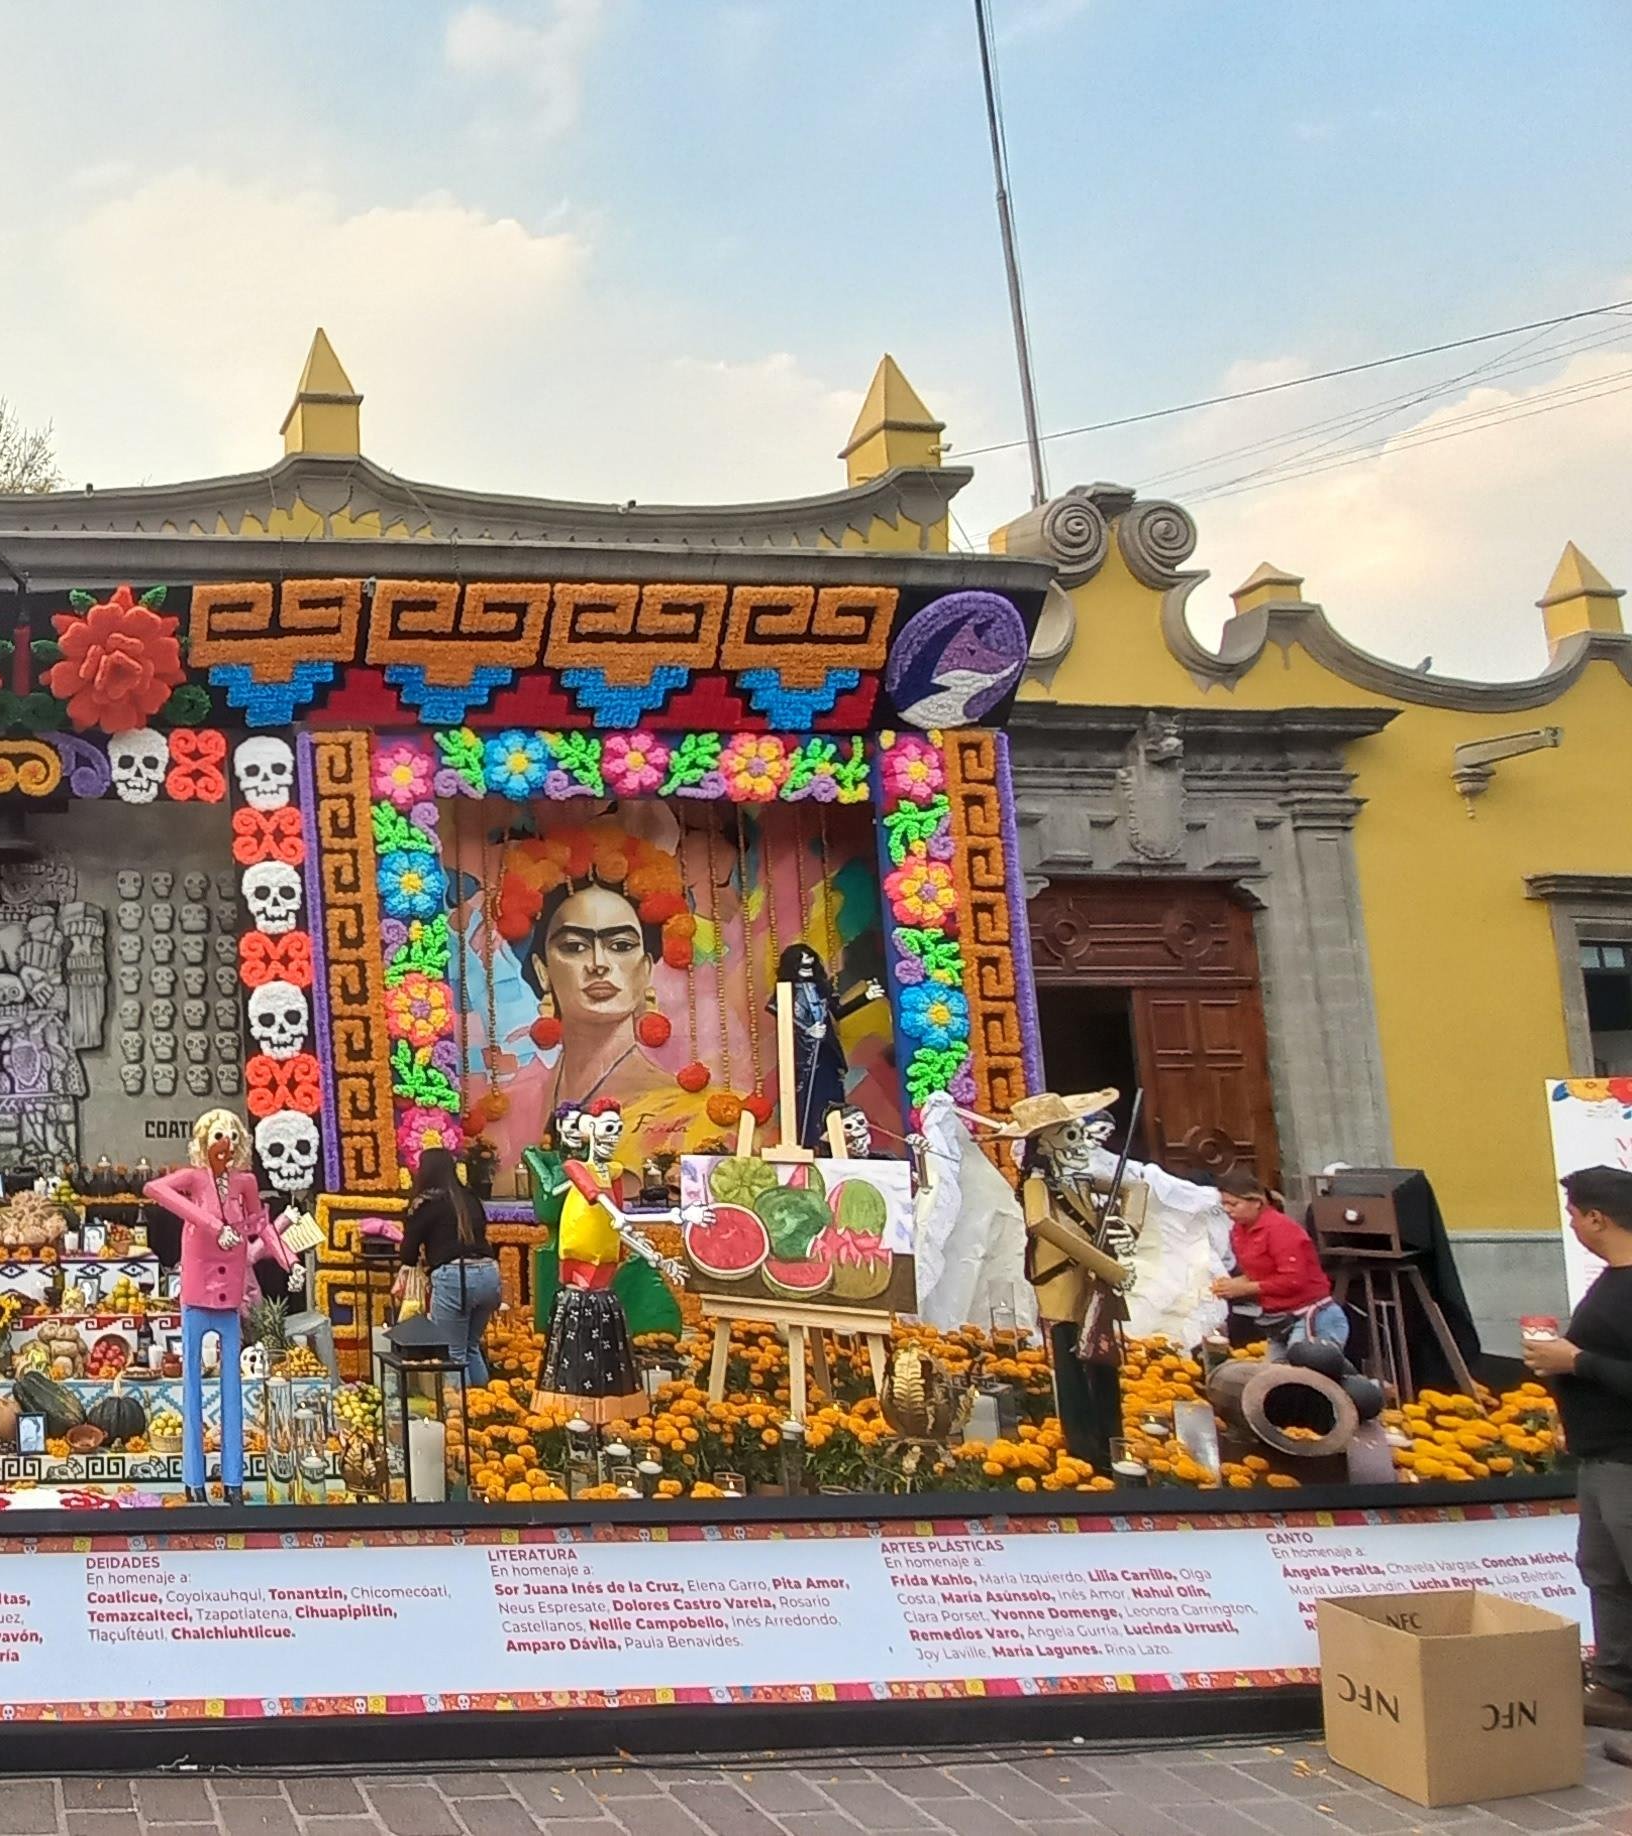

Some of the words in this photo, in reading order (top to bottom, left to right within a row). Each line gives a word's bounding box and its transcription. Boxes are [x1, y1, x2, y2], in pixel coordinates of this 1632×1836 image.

[880, 1541, 925, 1554] ARTES
[928, 1539, 1005, 1554] PLÁSTICAS
[1266, 1532, 1314, 1545] CANTO
[86, 1557, 160, 1569] DEIDADES
[488, 1548, 578, 1562] LITERATURA
[1283, 1565, 1330, 1580] Ángela
[1332, 1564, 1386, 1577] Peralta,
[1481, 1555, 1528, 1569] Concha
[86, 1573, 105, 1585] En
[107, 1572, 176, 1586] homenaje
[179, 1573, 192, 1583] a:
[494, 1583, 520, 1596] Sor
[522, 1582, 568, 1596] Juana
[572, 1581, 603, 1595] Inés
[607, 1581, 625, 1594] de
[628, 1581, 643, 1593] la
[646, 1580, 685, 1595] Cruz,
[687, 1579, 726, 1592] Elena
[772, 1578, 802, 1591] Pita
[805, 1577, 851, 1591] Amor,
[890, 1574, 930, 1588] Frida
[932, 1572, 978, 1587] Kahlo,
[980, 1572, 1017, 1585] María
[1089, 1570, 1120, 1583] Lilia
[1121, 1568, 1178, 1583] Carrillo,
[1179, 1568, 1212, 1583] Olga
[87, 1591, 163, 1605] Coatlicue,
[268, 1588, 348, 1602] Tonantzin,
[1541, 1586, 1577, 1598] Elvira
[88, 1610, 193, 1624] Temazcalteci,
[295, 1605, 398, 1621] Cihuapipiltin,
[909, 1627, 982, 1642] Remedios
[985, 1627, 1025, 1641] Varo,
[1124, 1622, 1181, 1636] Lucinda
[506, 1640, 566, 1655] Amparo
[570, 1637, 622, 1653] Dávila,
[625, 1637, 665, 1650] Paula
[1337, 1674, 1400, 1723] NFC
[1481, 1700, 1537, 1732] NFC
